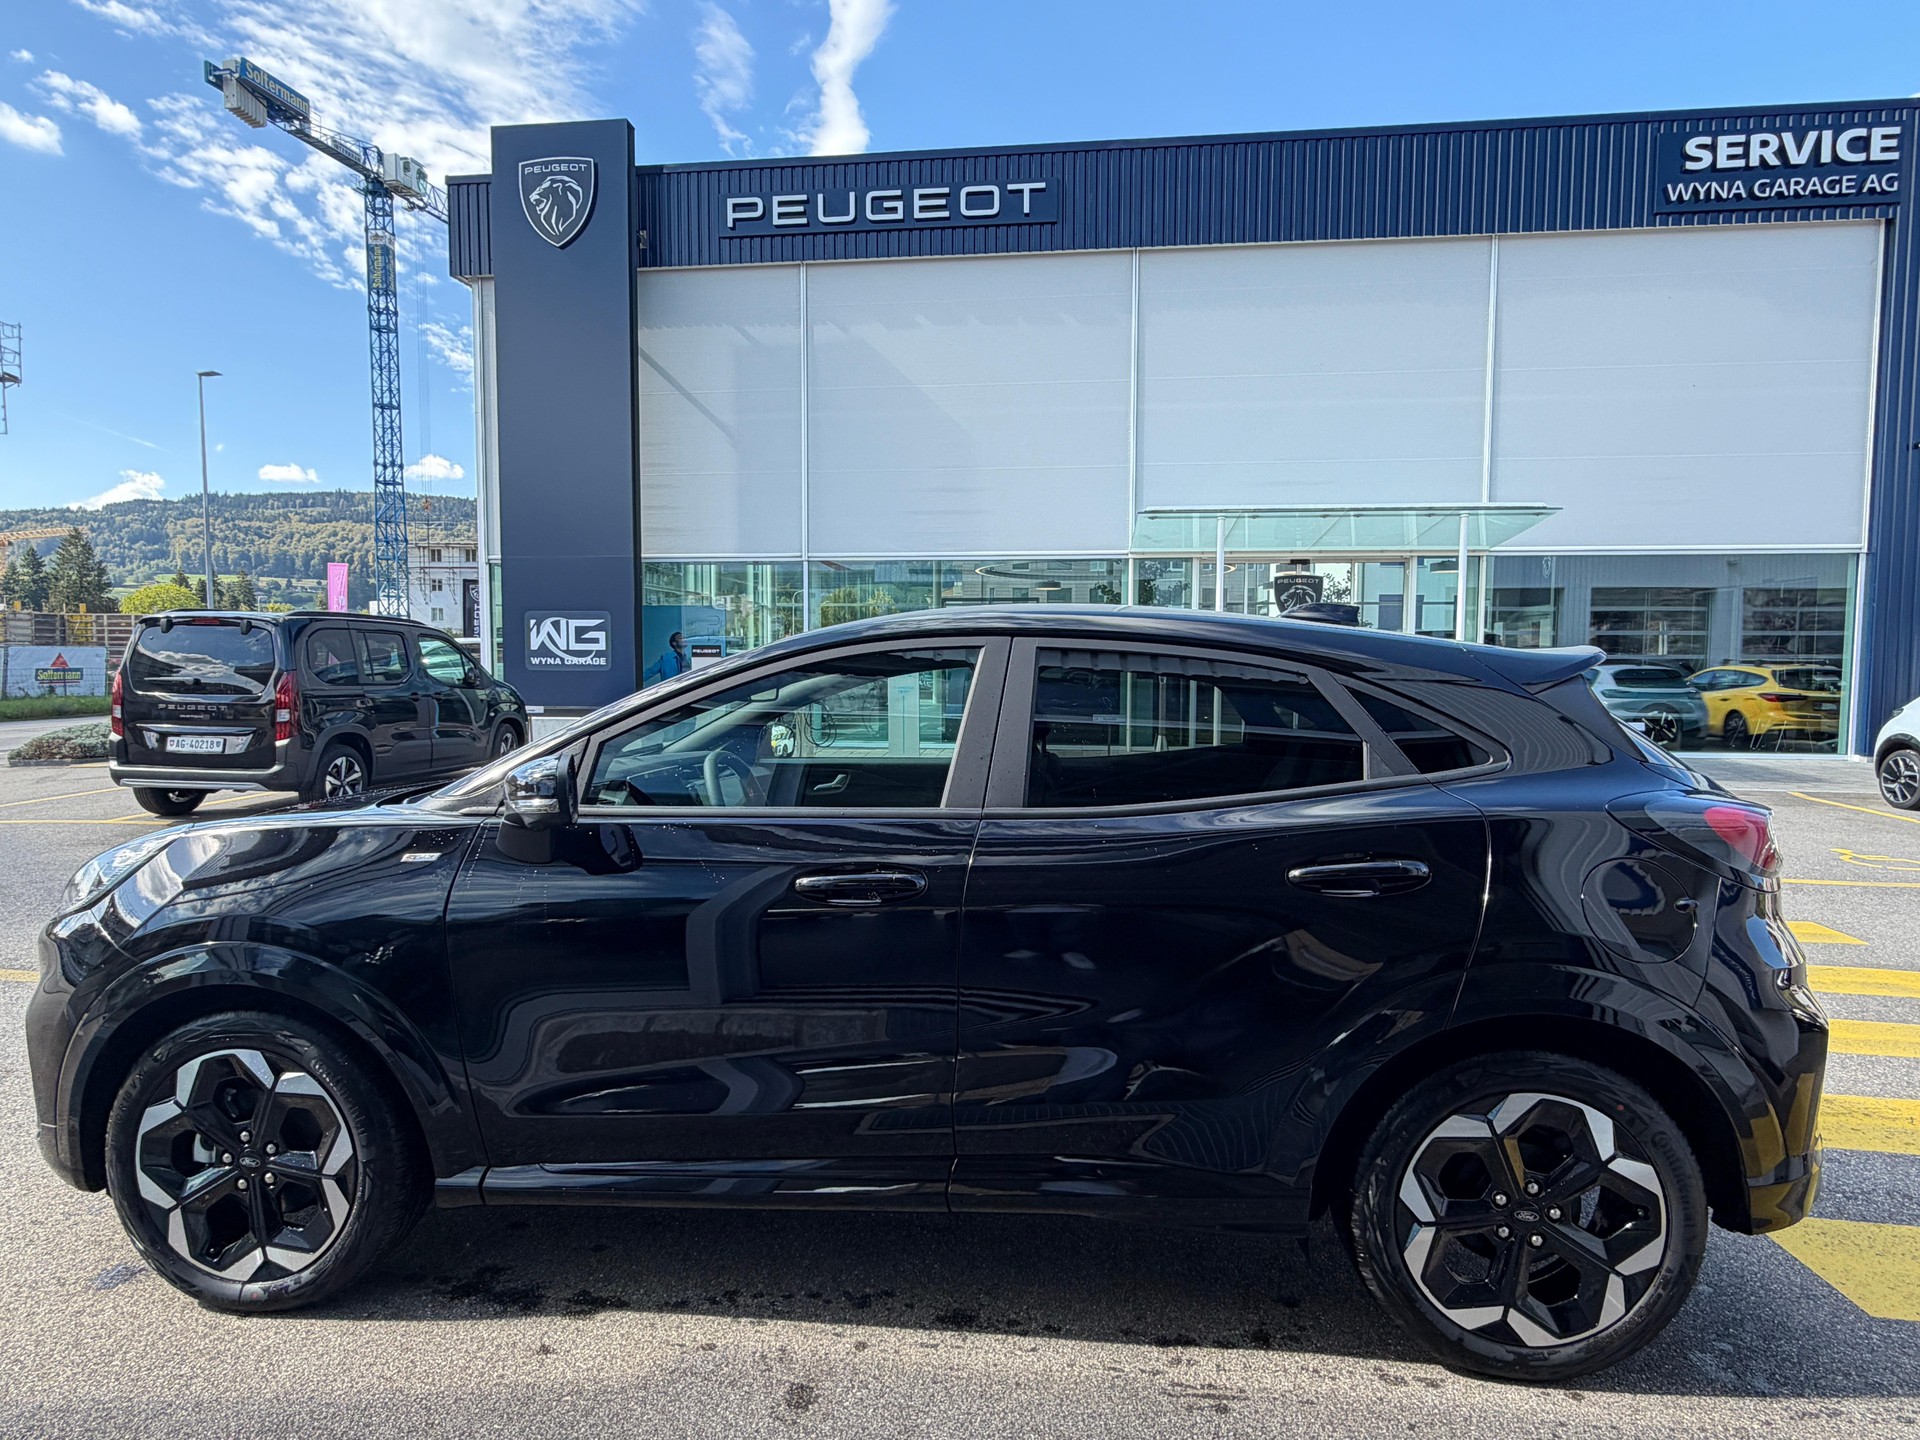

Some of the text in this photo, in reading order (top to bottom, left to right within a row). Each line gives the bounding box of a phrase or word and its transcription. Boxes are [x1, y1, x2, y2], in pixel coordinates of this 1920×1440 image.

[245, 62, 310, 115] Soltermann
[1684, 126, 1902, 171] SERVICE
[525, 163, 587, 175] PEUGEOT
[1666, 172, 1899, 202] WYNA GARAGE AG
[726, 181, 1047, 229] PEUGEOT
[530, 656, 607, 665] WYNA GARAGE
[158, 703, 228, 712] PEUGEOT
